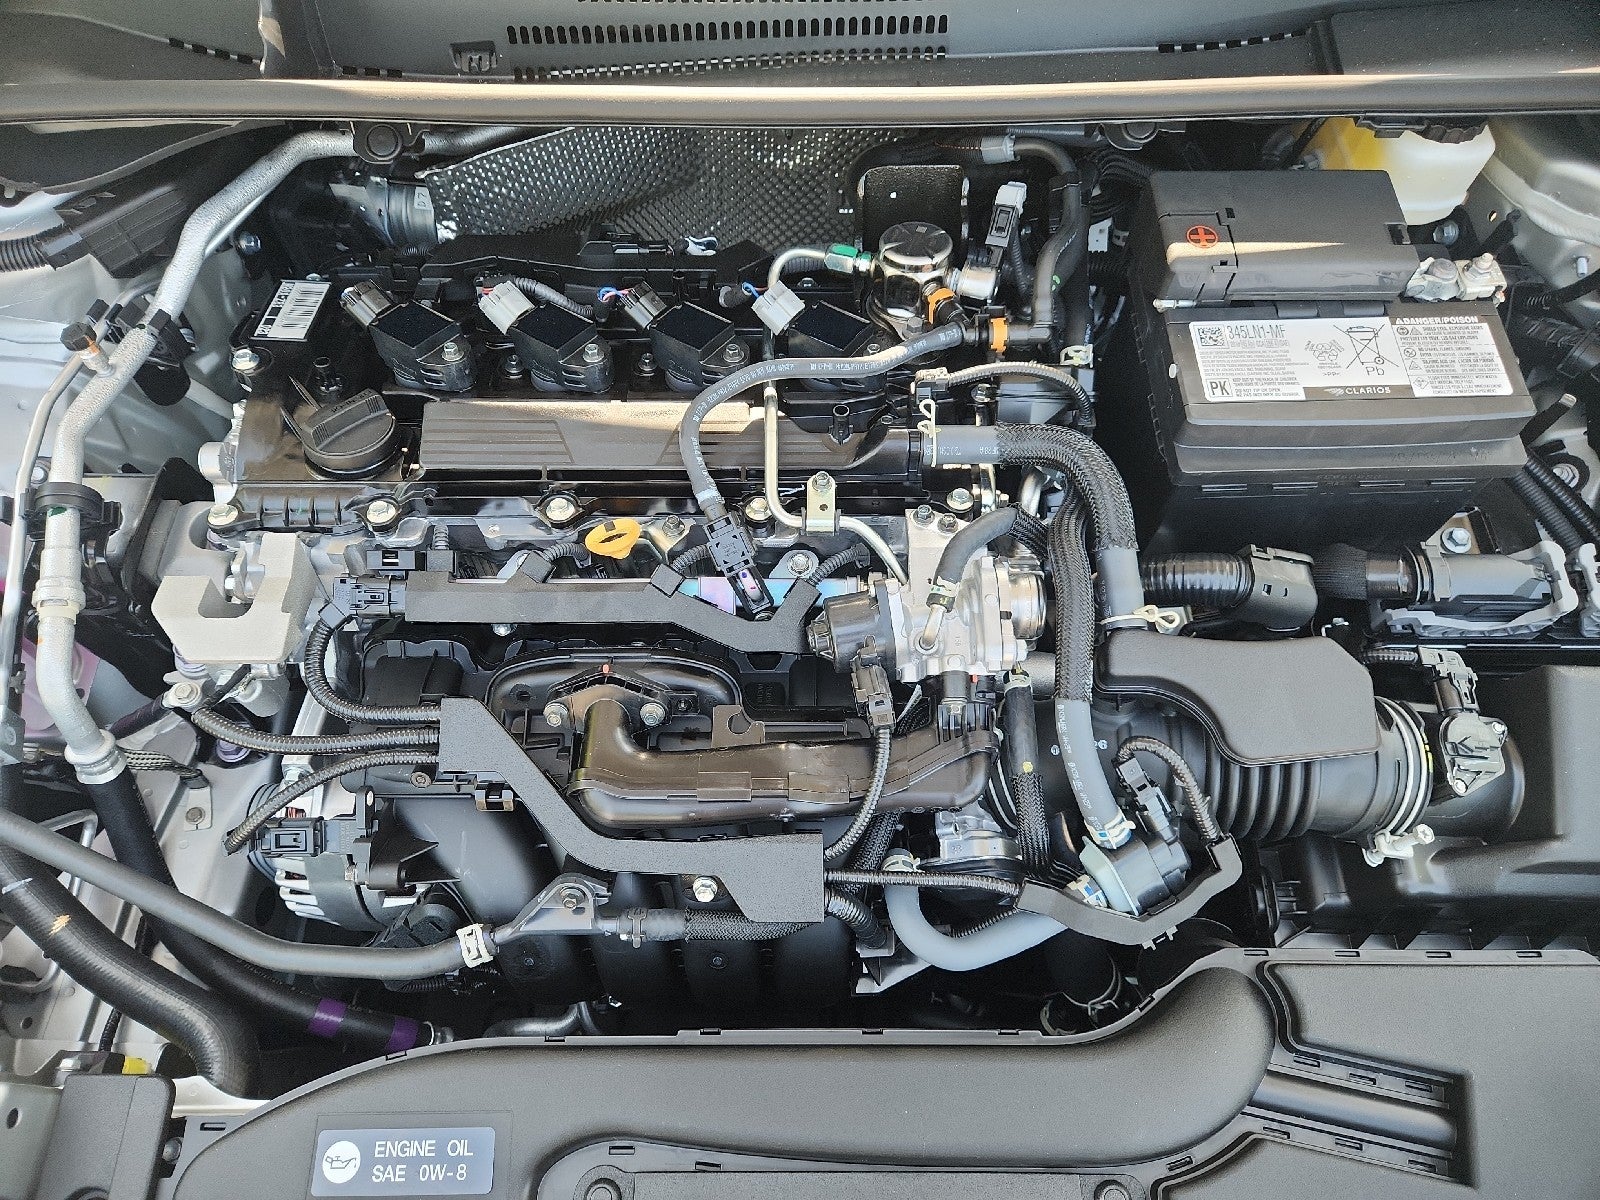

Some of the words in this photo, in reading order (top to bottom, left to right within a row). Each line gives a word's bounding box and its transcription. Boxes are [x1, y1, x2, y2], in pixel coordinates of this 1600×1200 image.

[1403, 315, 1479, 325] DANGER/POISON
[1226, 324, 1287, 340] 345LN1-MF
[1365, 366, 1385, 376] Pb
[1209, 381, 1230, 396] PK
[1345, 387, 1391, 395] CLARIOS
[374, 1140, 436, 1158] ENGINE
[447, 1139, 474, 1157] OIL
[371, 1164, 406, 1183] SAE
[419, 1163, 467, 1182] 0W-8
